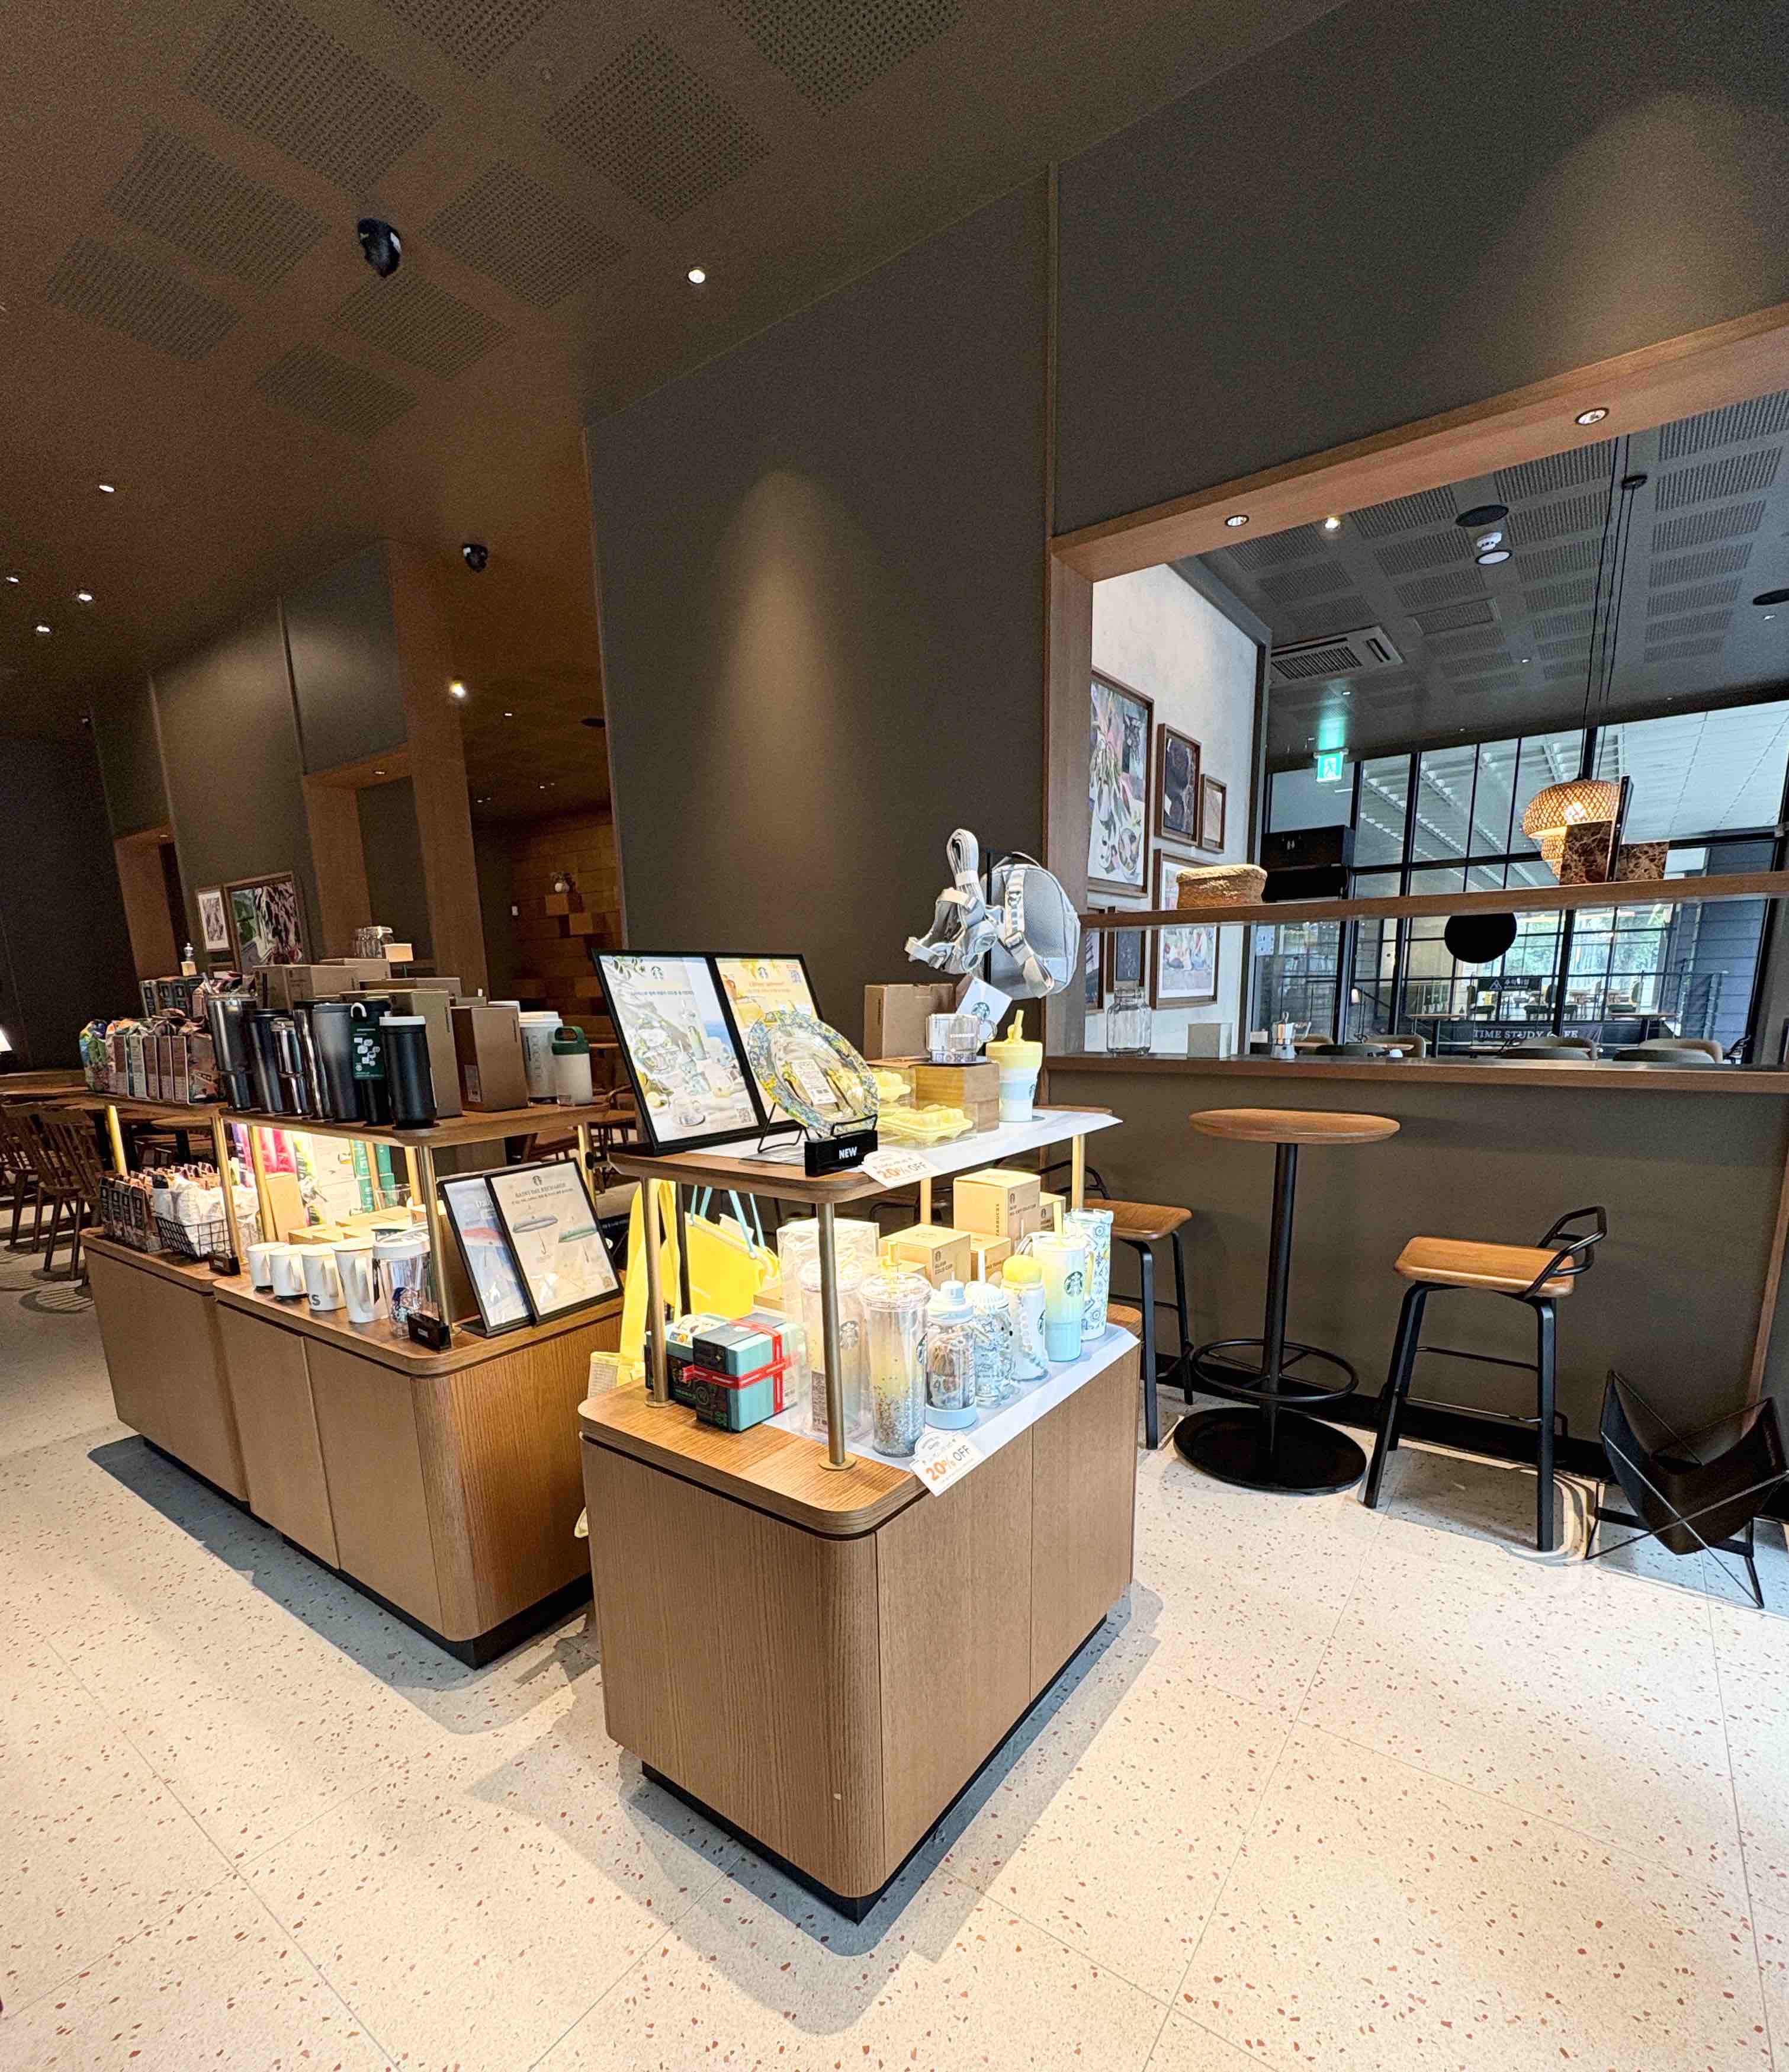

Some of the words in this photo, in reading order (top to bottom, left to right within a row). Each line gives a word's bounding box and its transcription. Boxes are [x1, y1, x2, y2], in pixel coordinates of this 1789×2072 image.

[1474, 1029, 1502, 1038] TIME
[1547, 1030, 1578, 1038] CFE
[839, 1146, 858, 1160] NEW
[876, 1165, 910, 1179] 20%
[908, 1162, 928, 1171] OFF
[926, 1459, 956, 1481] 20%
[952, 1445, 971, 1461] OFF
